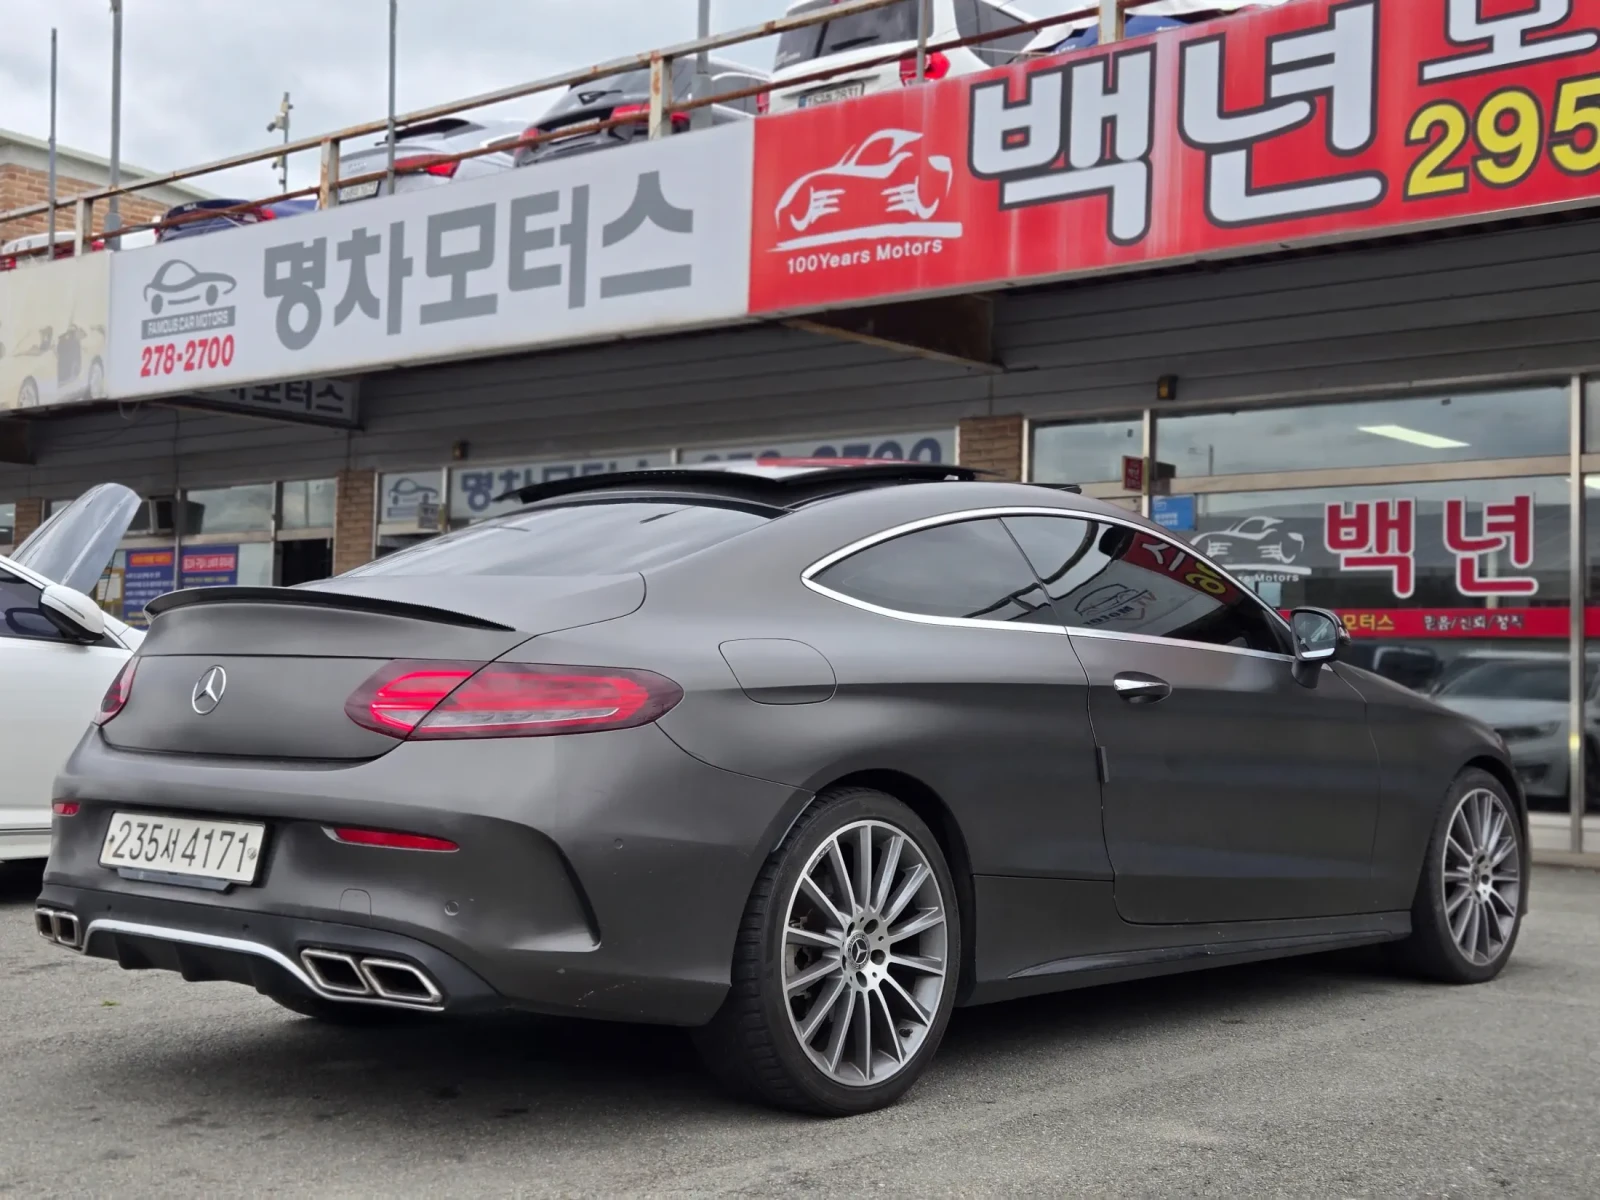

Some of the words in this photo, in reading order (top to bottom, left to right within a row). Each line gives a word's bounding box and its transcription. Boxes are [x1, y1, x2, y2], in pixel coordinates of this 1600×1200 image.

[1403, 72, 1600, 203] 295
[264, 170, 694, 351] 명차모터스
[876, 239, 943, 261] Motors
[179, 315, 195, 331] CAR
[196, 310, 229, 327] MOTORS
[141, 334, 235, 378] 278-2700
[1254, 573, 1300, 582] Motors
